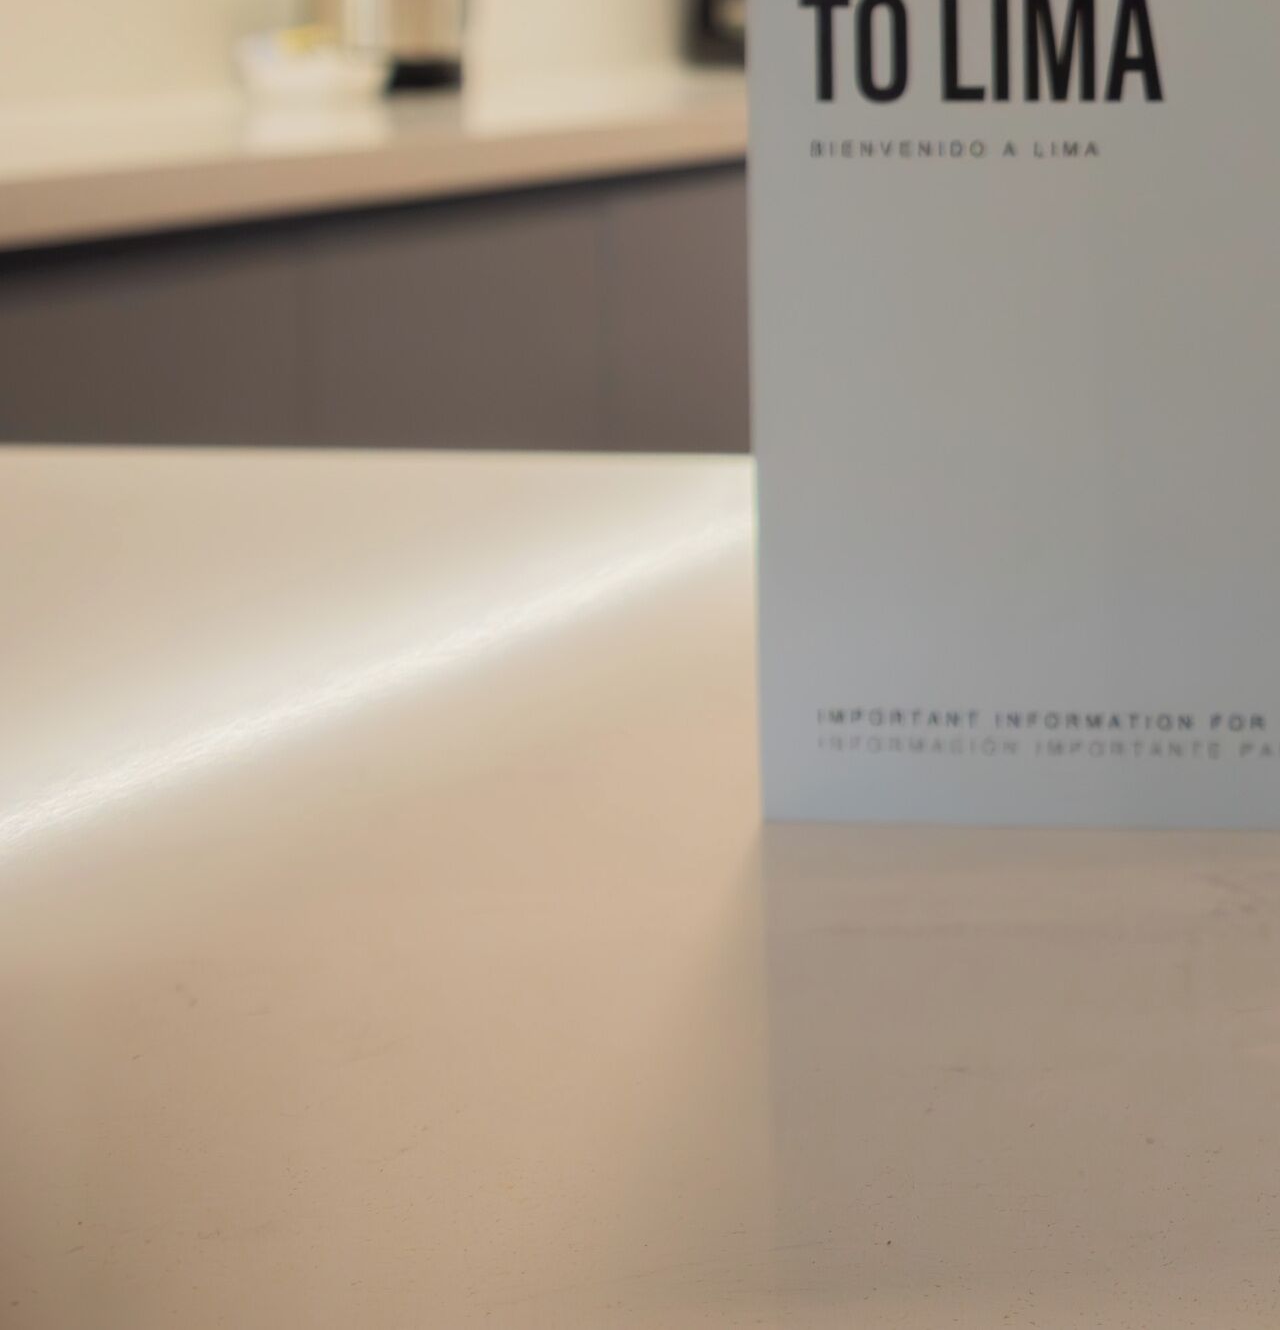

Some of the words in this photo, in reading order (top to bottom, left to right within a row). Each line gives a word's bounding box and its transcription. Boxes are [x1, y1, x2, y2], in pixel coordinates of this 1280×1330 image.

[809, 140, 987, 158] BIENVENIDO
[1003, 141, 1018, 158] A
[1033, 141, 1101, 158] LIMA
[817, 708, 980, 727] IMPORTANT
[995, 710, 1195, 732] INFORMATION
[1209, 714, 1266, 731] FOR
[1035, 739, 1220, 759] IMPORTANTE
